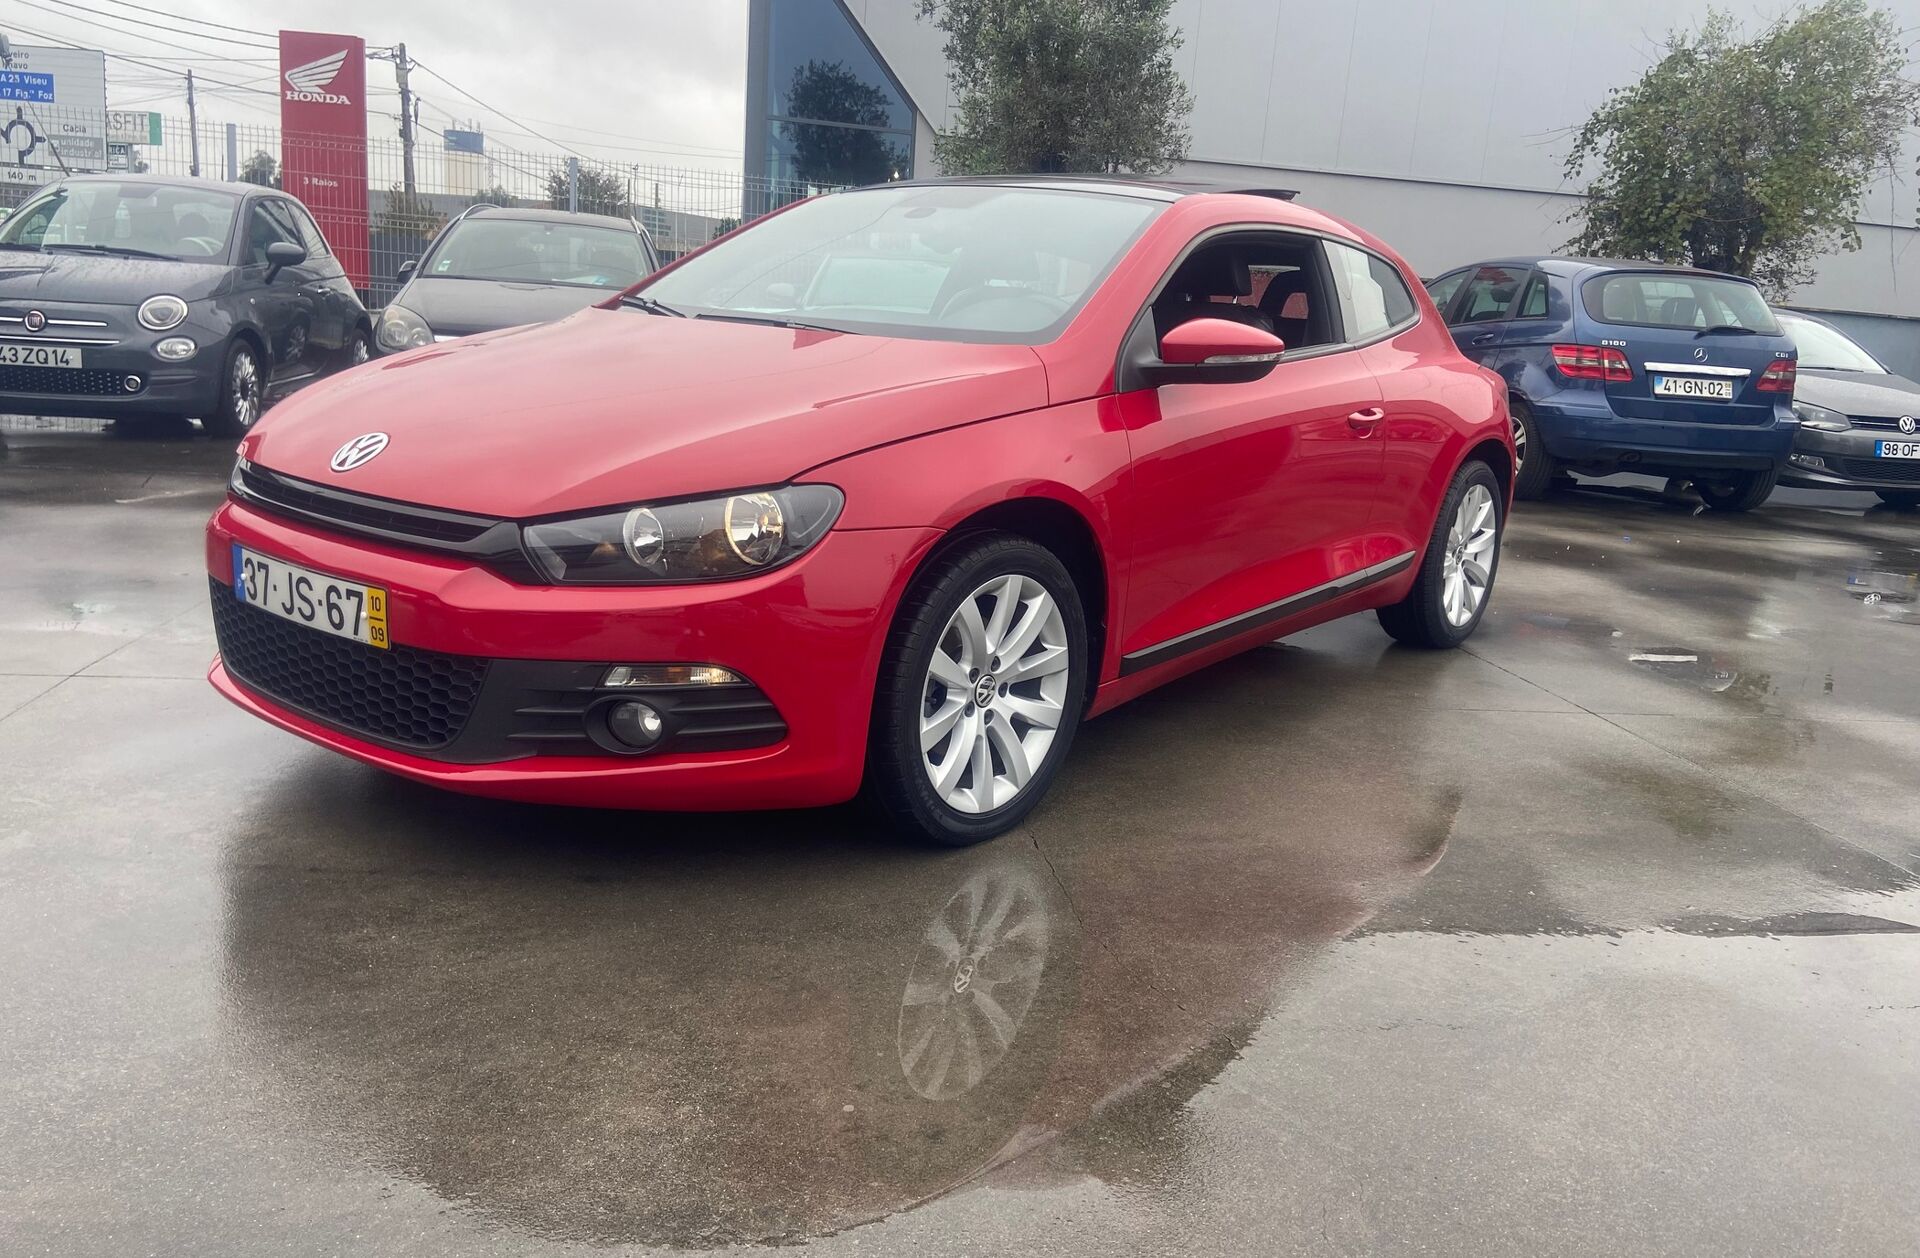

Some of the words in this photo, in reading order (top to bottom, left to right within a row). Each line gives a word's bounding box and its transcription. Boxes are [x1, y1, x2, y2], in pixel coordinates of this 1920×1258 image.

[23, 75, 48, 86] Viseu
[38, 90, 53, 100] Foz
[285, 90, 351, 105] HONDA
[62, 123, 87, 133] Cacia
[8, 171, 24, 180] 140
[303, 176, 310, 185] 3
[370, 595, 381, 612] 10
[371, 625, 385, 642] 09
